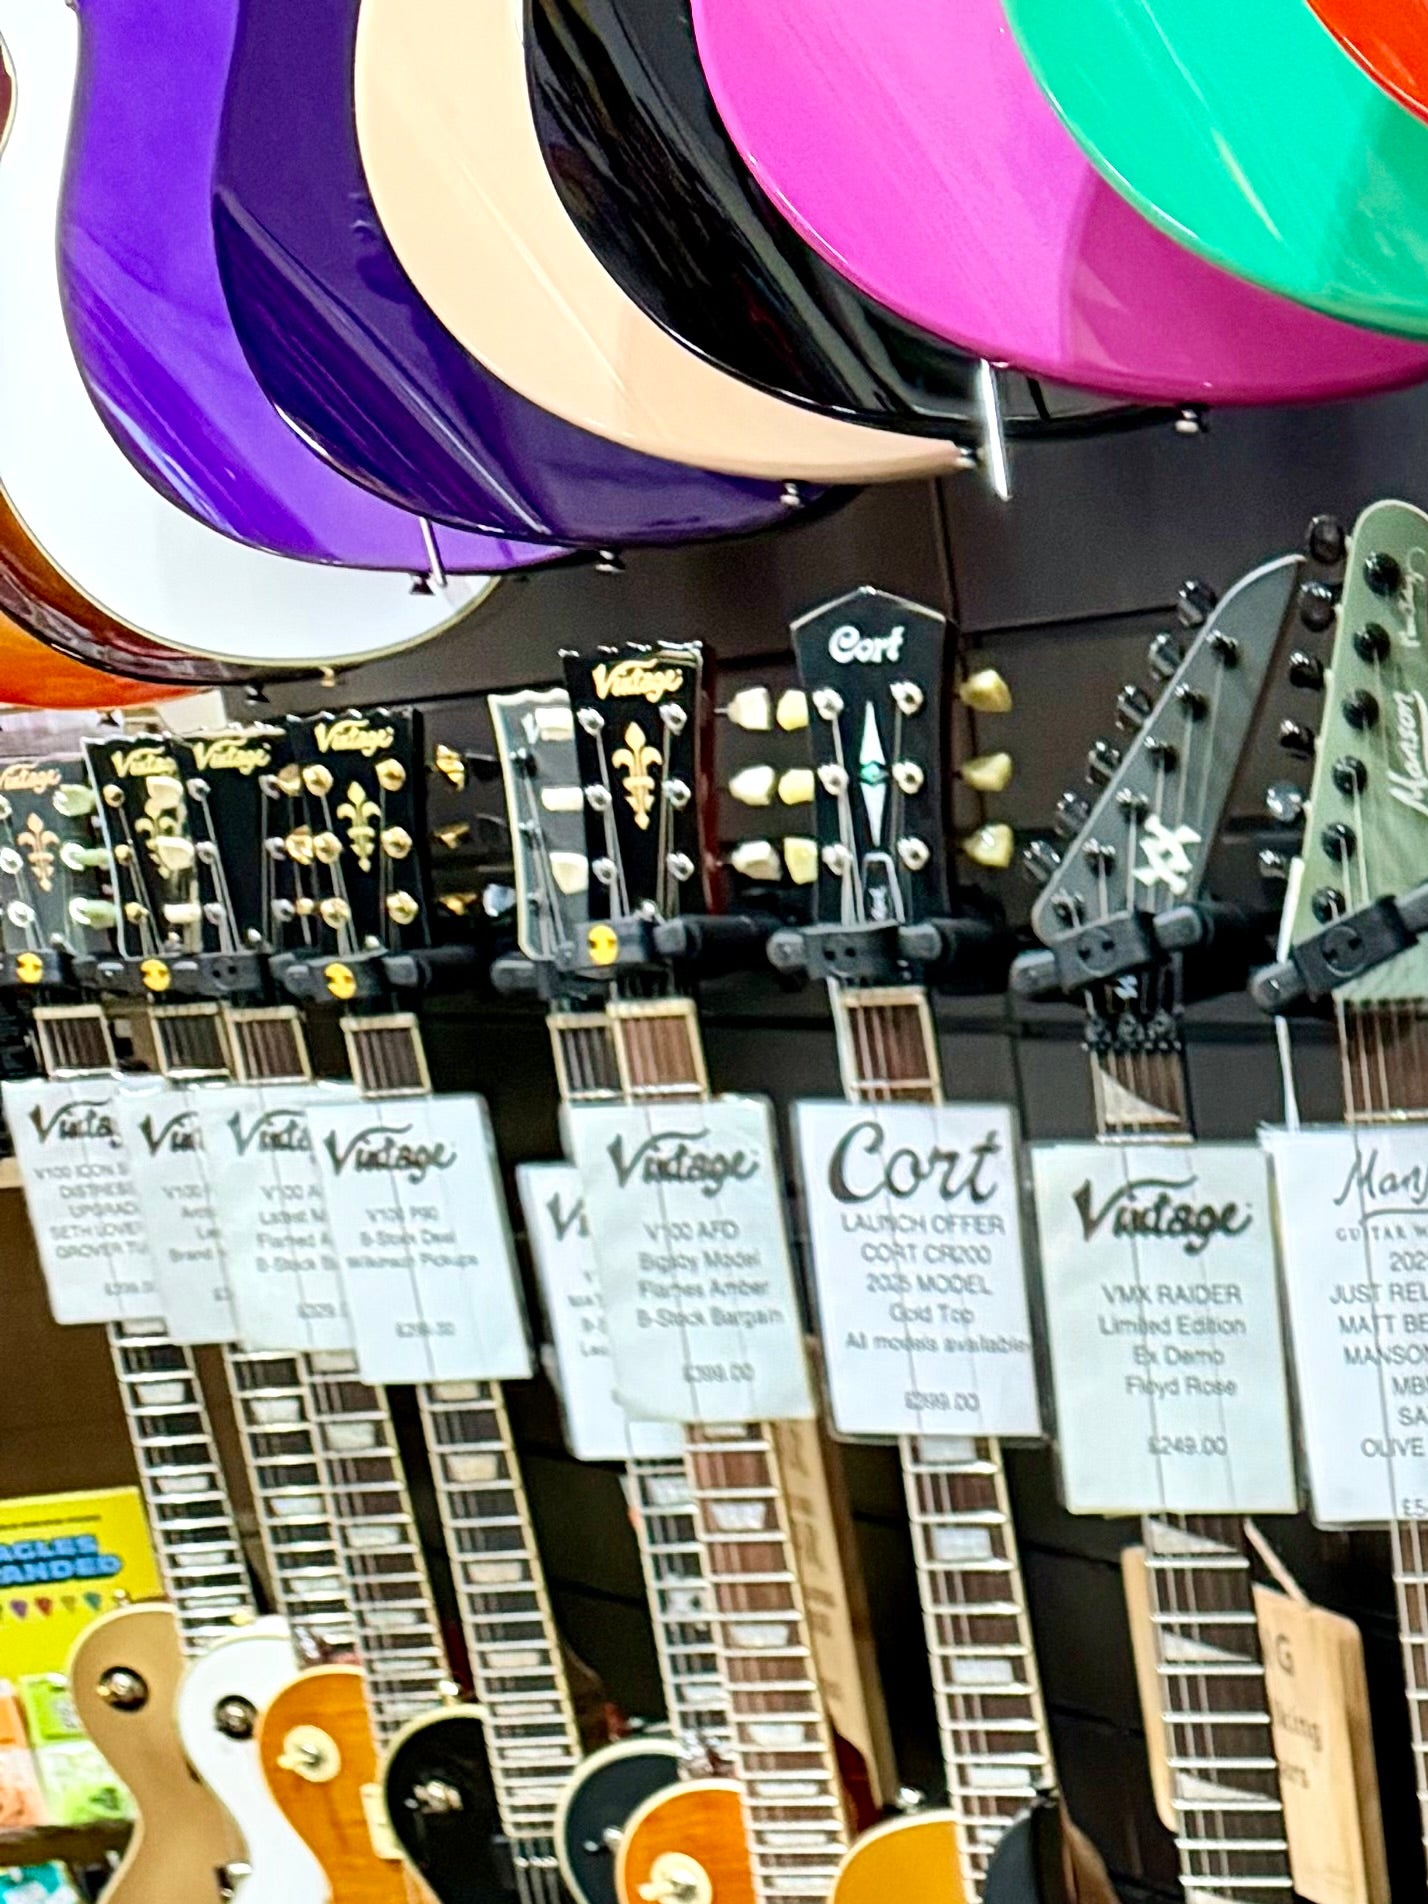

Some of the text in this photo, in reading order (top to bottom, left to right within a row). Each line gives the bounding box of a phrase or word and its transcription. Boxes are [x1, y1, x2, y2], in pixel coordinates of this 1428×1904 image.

[829, 625, 905, 664] Cort
[323, 1123, 458, 1185] Vintage
[607, 1126, 759, 1198] Vintage
[828, 1121, 1003, 1205] Cort
[841, 1213, 1006, 1236] LAUNCH OFFER
[1073, 1173, 1253, 1257] Vintage
[861, 1242, 918, 1264] CORT
[916, 1273, 995, 1296] MODEL
[1101, 1282, 1244, 1305] VMX RAIDER
[1328, 1281, 1384, 1305] JUST
[1098, 1314, 1248, 1337] Limited Edition
[1337, 1312, 1398, 1336] MATT
[1164, 1345, 1227, 1367] Demo
[1124, 1375, 1239, 1401] Floyd Rose
[1359, 1434, 1426, 1459] OLIVE
